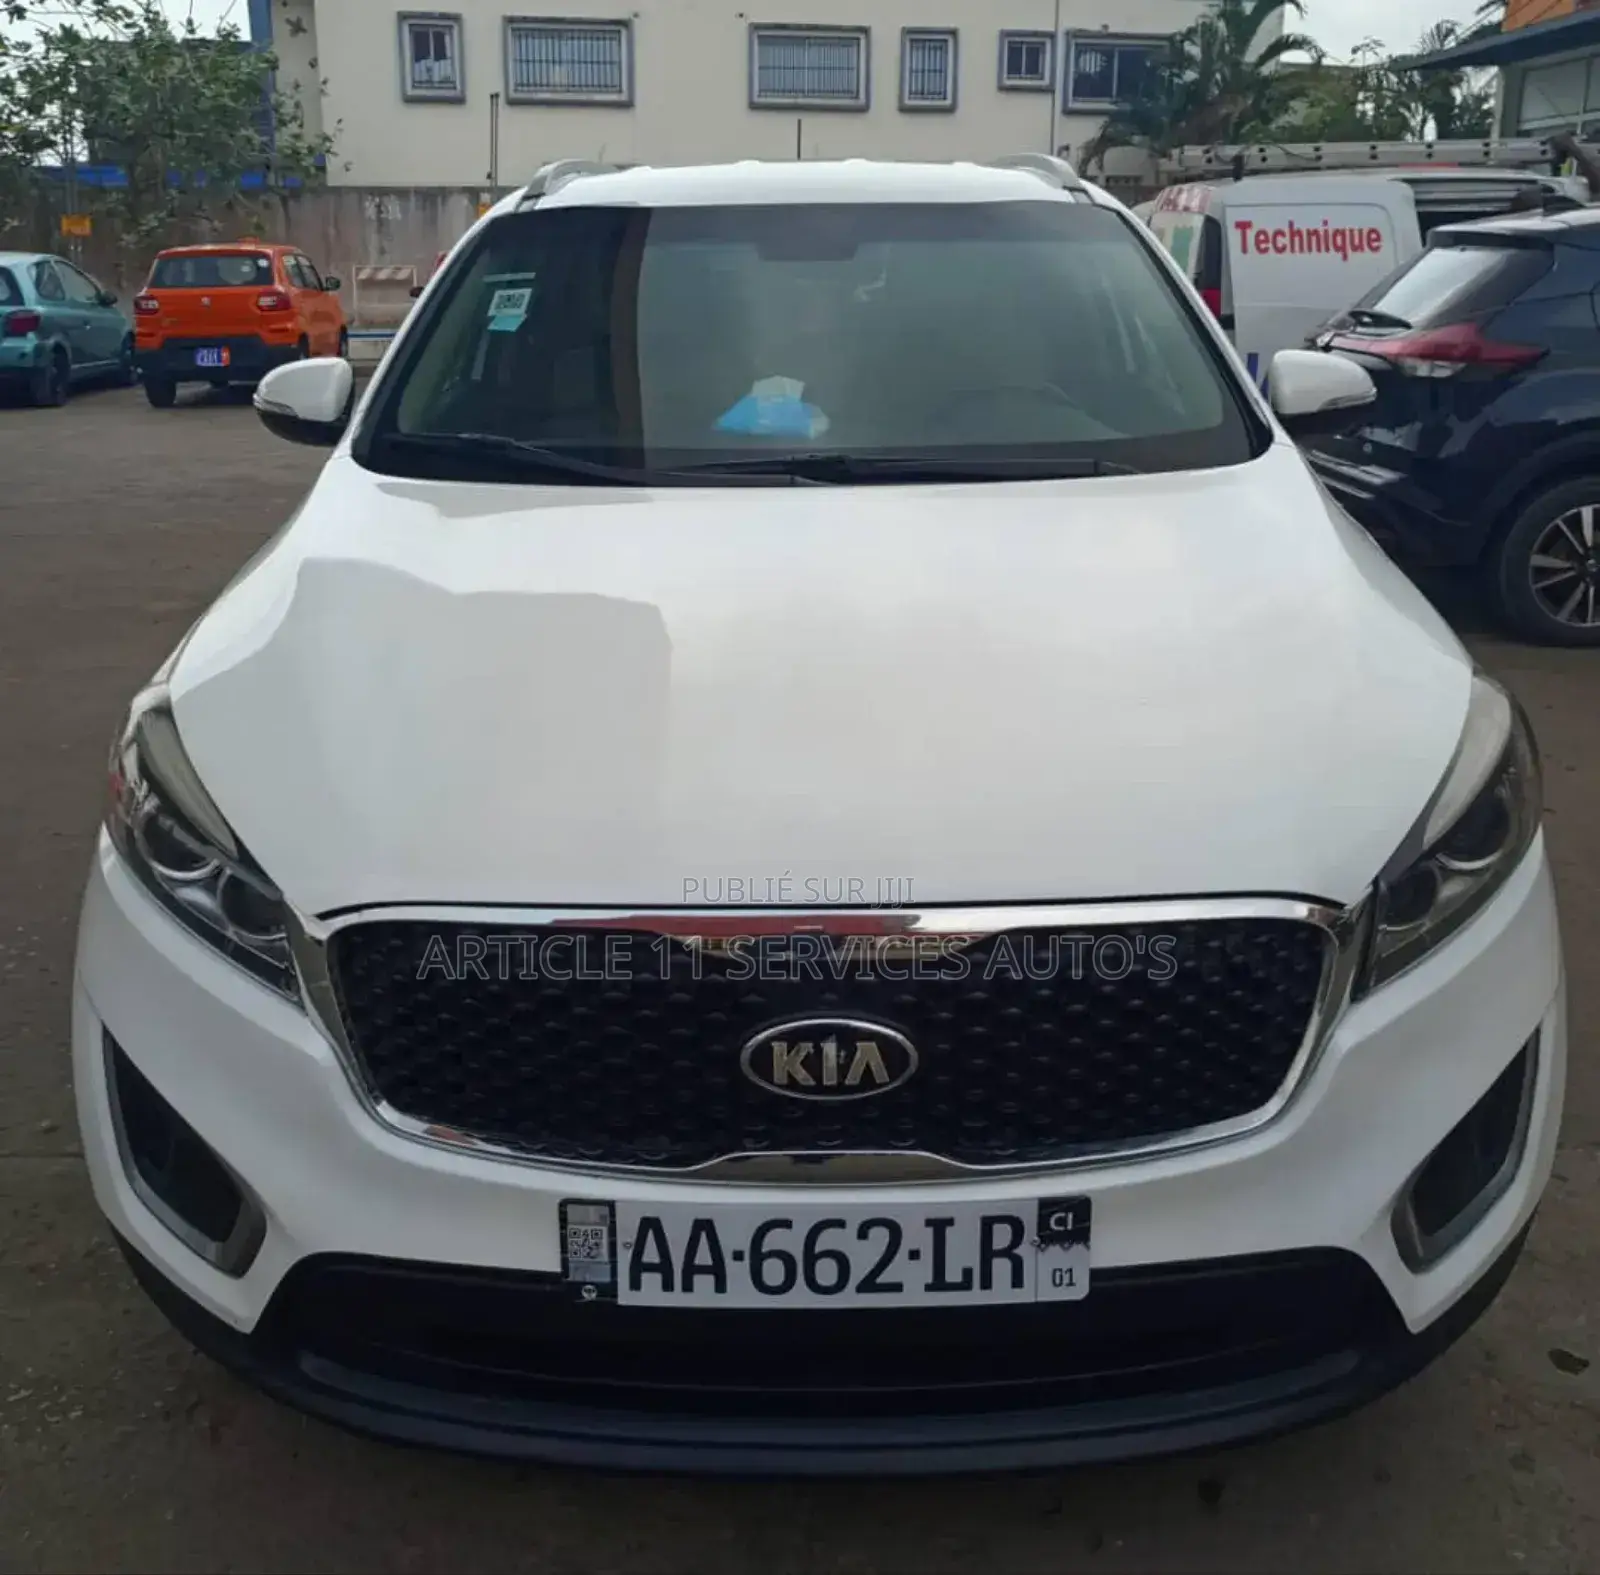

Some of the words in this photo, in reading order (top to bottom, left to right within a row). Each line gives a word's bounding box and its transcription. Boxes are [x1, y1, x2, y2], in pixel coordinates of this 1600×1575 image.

[1234, 219, 1382, 262] Technique
[771, 1040, 890, 1086] KIA
[1050, 1211, 1073, 1231] CI
[1052, 1267, 1077, 1288] 01
